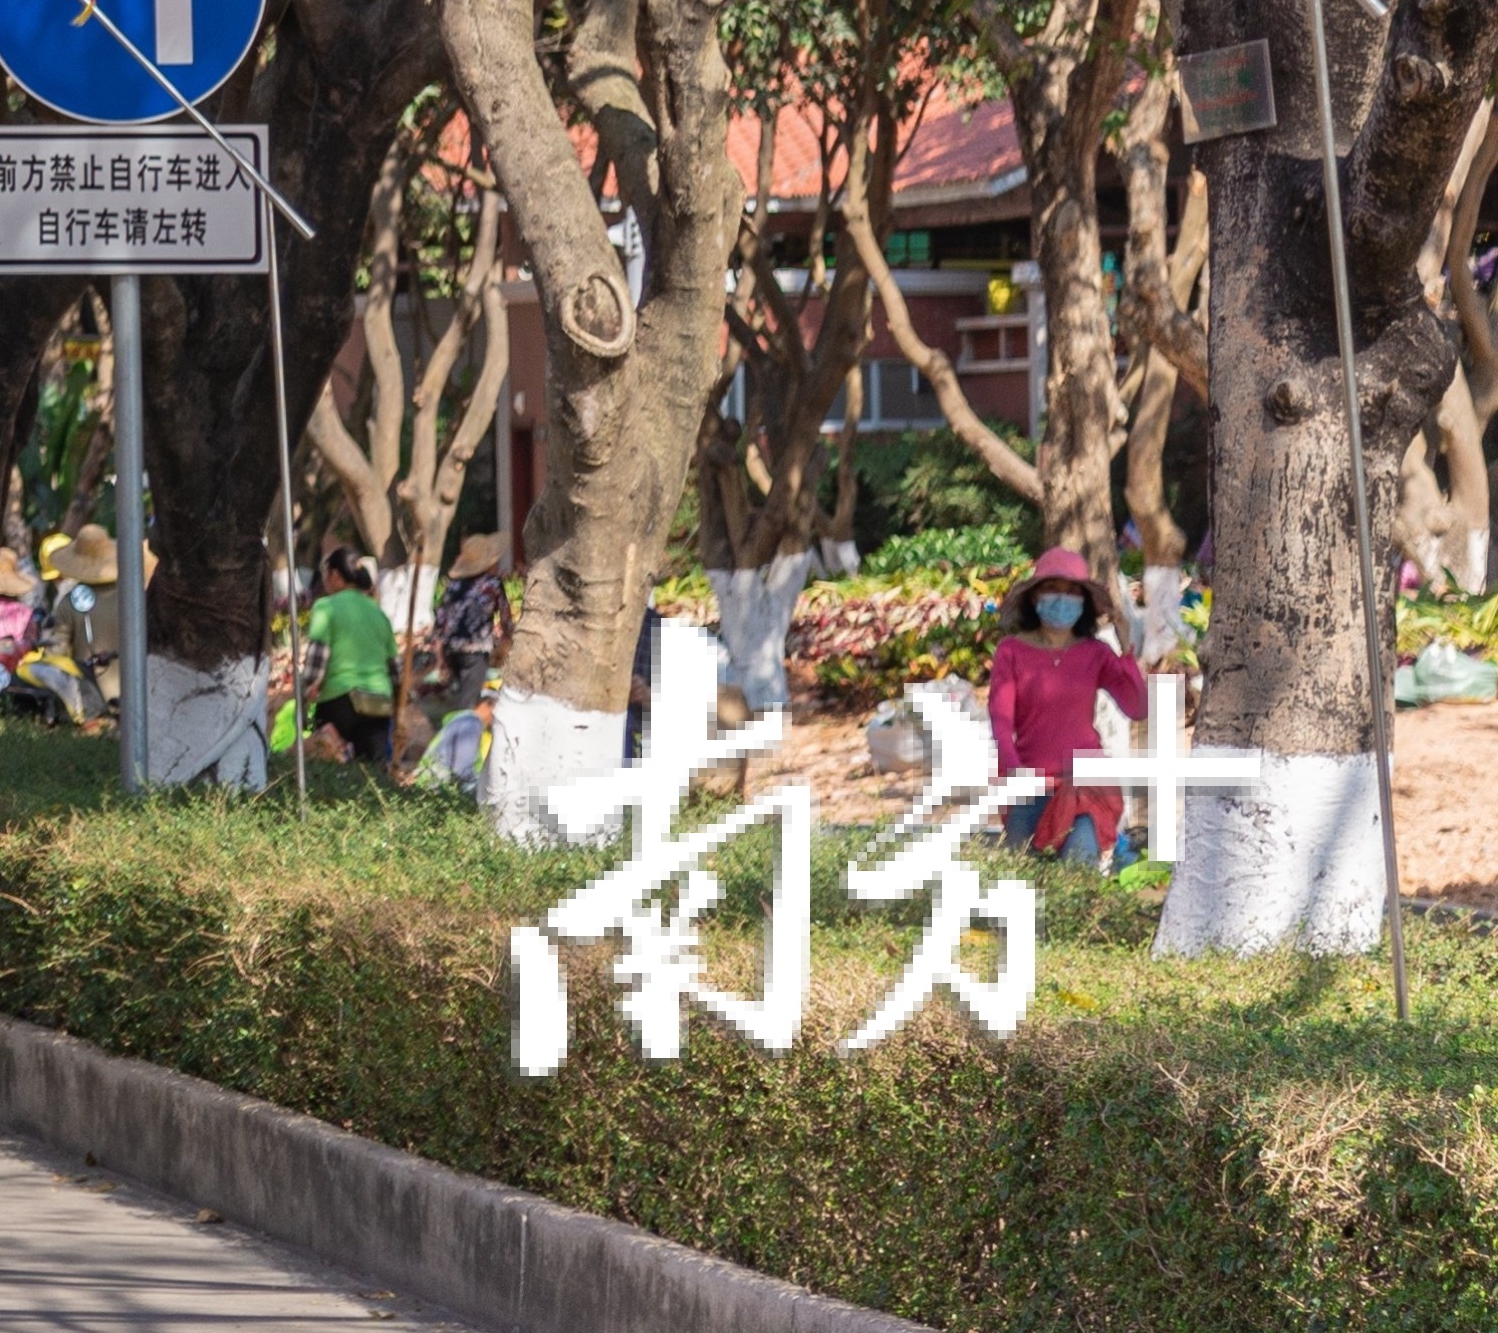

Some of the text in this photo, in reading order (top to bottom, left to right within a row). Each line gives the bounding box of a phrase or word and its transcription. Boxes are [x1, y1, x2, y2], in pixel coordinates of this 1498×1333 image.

[39, 207, 208, 247] 自行车请左转
